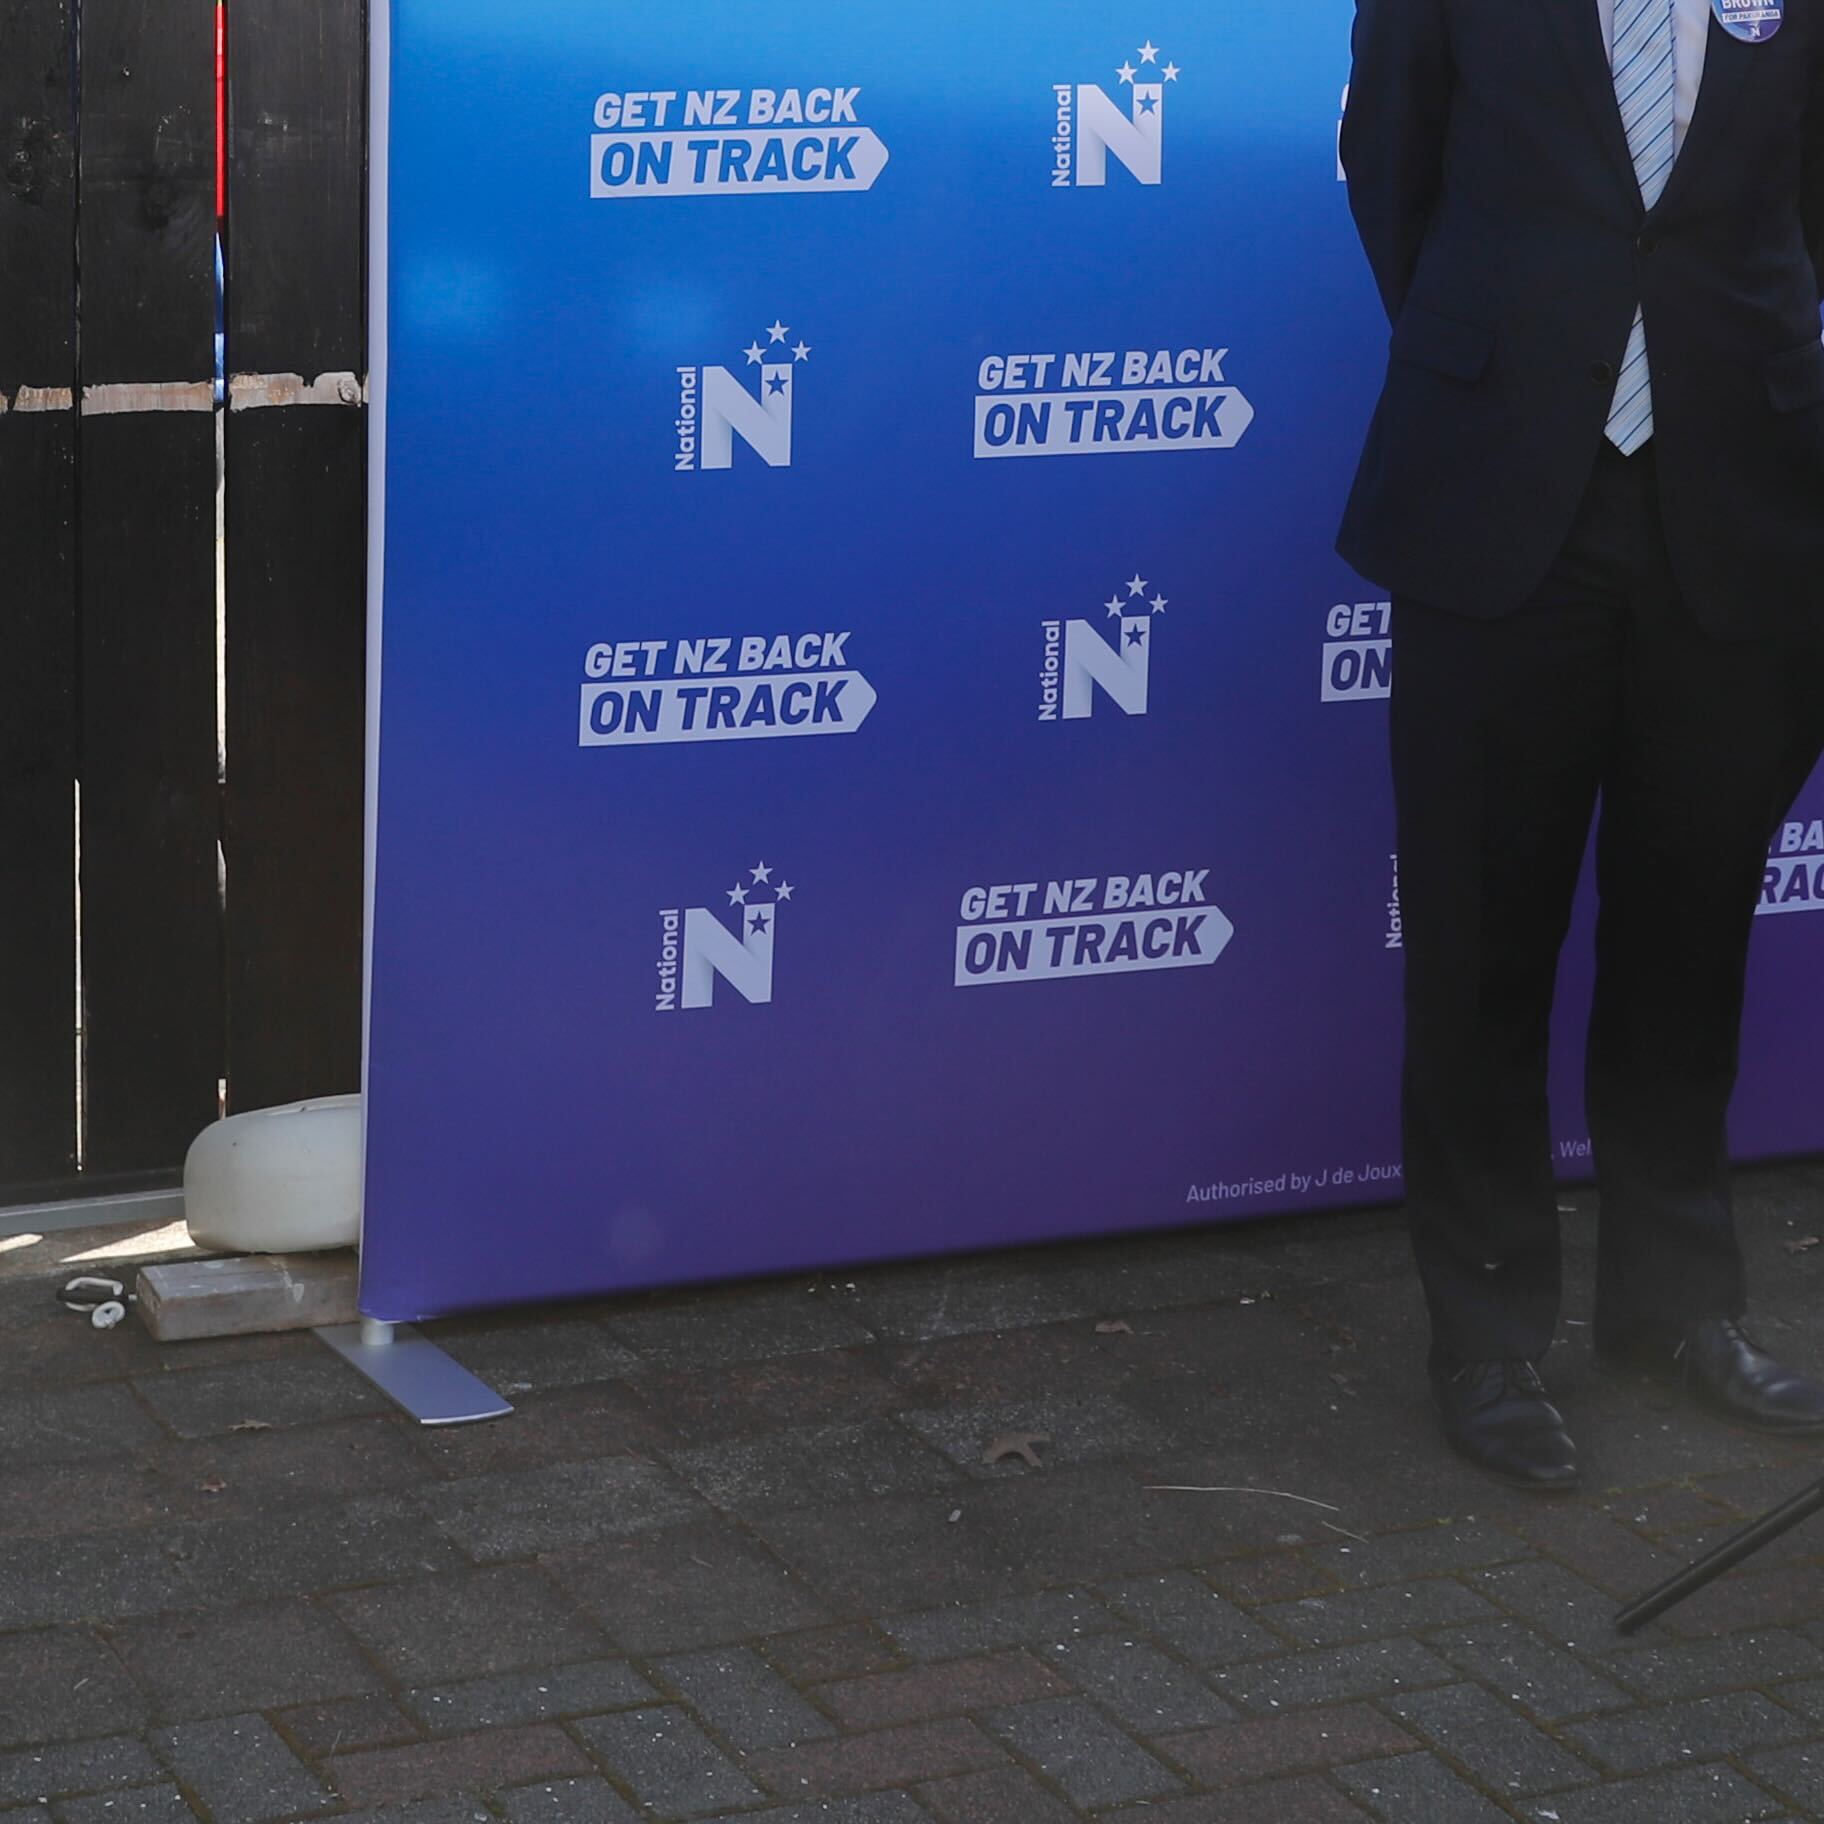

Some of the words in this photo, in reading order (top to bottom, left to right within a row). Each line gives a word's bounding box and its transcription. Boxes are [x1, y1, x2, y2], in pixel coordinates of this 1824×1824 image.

[593, 91, 676, 129] GET
[683, 90, 738, 126] NZ
[748, 87, 860, 124] BACK
[1052, 84, 1072, 187] National
[601, 138, 672, 186] ON
[687, 136, 861, 183] TRACK
[978, 354, 1055, 390] GET
[1059, 352, 1114, 387] NZ
[1122, 348, 1229, 384] BACK
[675, 366, 697, 471] National
[983, 401, 1051, 446] ON
[1063, 396, 1227, 442] TRACK
[584, 641, 667, 678] GET
[674, 638, 731, 674] NZ
[739, 632, 851, 670] BACK
[1038, 620, 1060, 721] National
[1331, 647, 1392, 691] ON
[589, 690, 661, 735] ON
[677, 680, 849, 730] TRACK
[960, 884, 1042, 920] GET
[1043, 879, 1097, 913] NZ
[1103, 870, 1210, 909] BACK
[656, 909, 679, 1011] National
[964, 932, 1032, 975] ON
[1046, 914, 1207, 969] TRACK
[1186, 1174, 1286, 1203] Authorised
[1291, 1173, 1312, 1193] by
[1315, 1169, 1327, 1186] J
[1332, 1167, 1354, 1185] de
[1358, 1162, 1402, 1182] Joux
